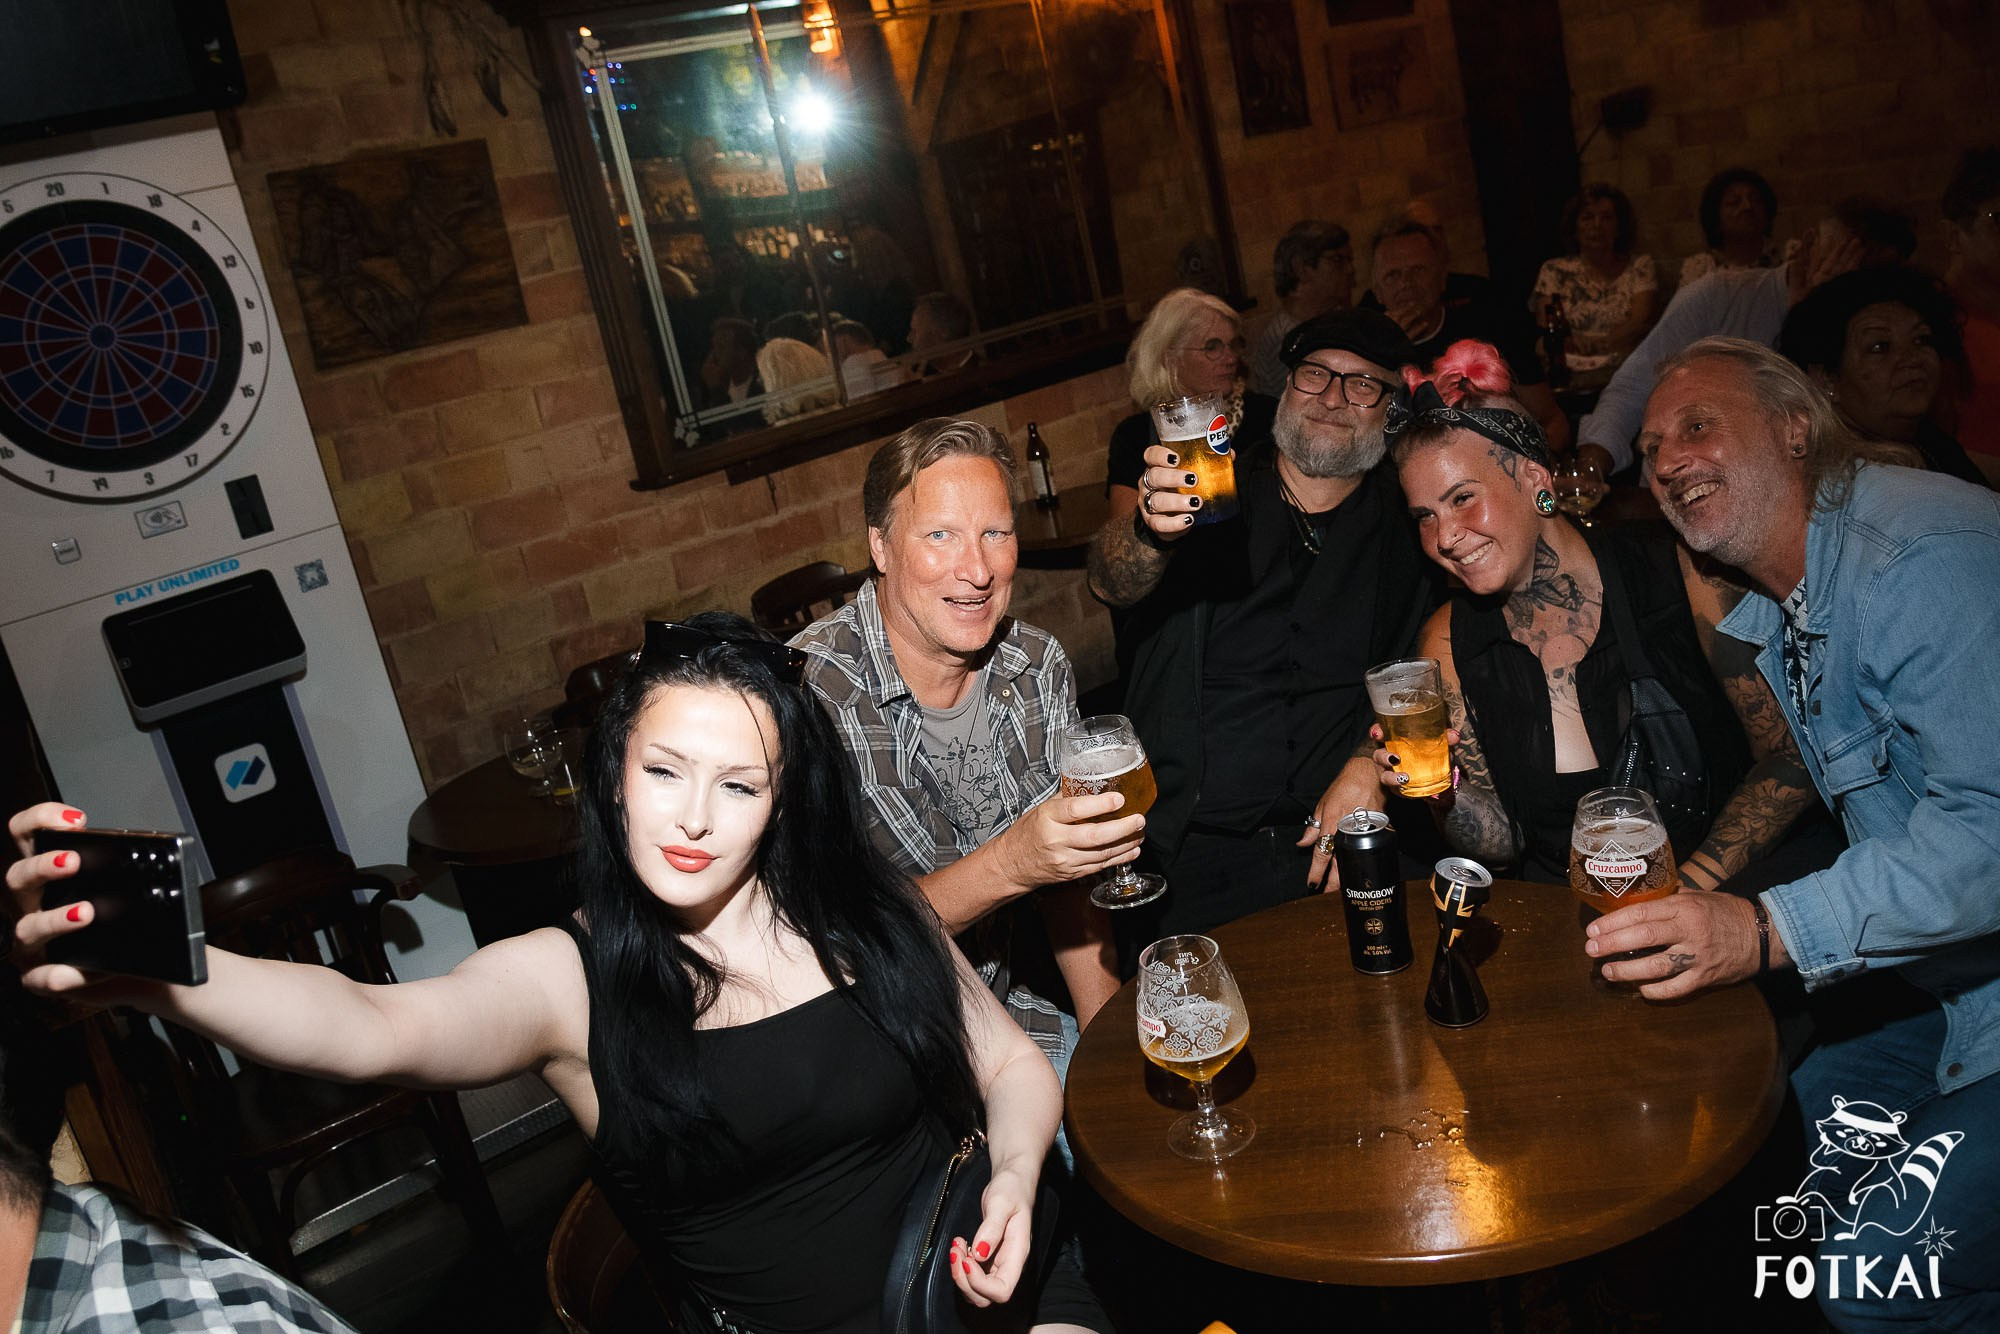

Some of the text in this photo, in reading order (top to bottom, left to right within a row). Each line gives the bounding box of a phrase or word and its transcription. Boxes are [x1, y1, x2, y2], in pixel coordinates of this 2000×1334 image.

[46, 182, 65, 197] 20
[102, 182, 109, 195] 1
[4, 200, 14, 214] 5
[147, 194, 163, 208] 18
[191, 220, 201, 232] 4
[222, 255, 238, 269] 13
[244, 297, 255, 310] 6
[248, 342, 264, 355] 10
[240, 386, 256, 399] 15
[220, 423, 231, 436] 2
[185, 454, 199, 468] 17
[46, 470, 55, 483] 7
[144, 472, 154, 485] 3
[93, 477, 109, 492] 19
[115, 559, 240, 605] PLAY UNLIMITED
[1588, 861, 1643, 874] Cruzcampo
[1346, 885, 1396, 899] STRONGBOW
